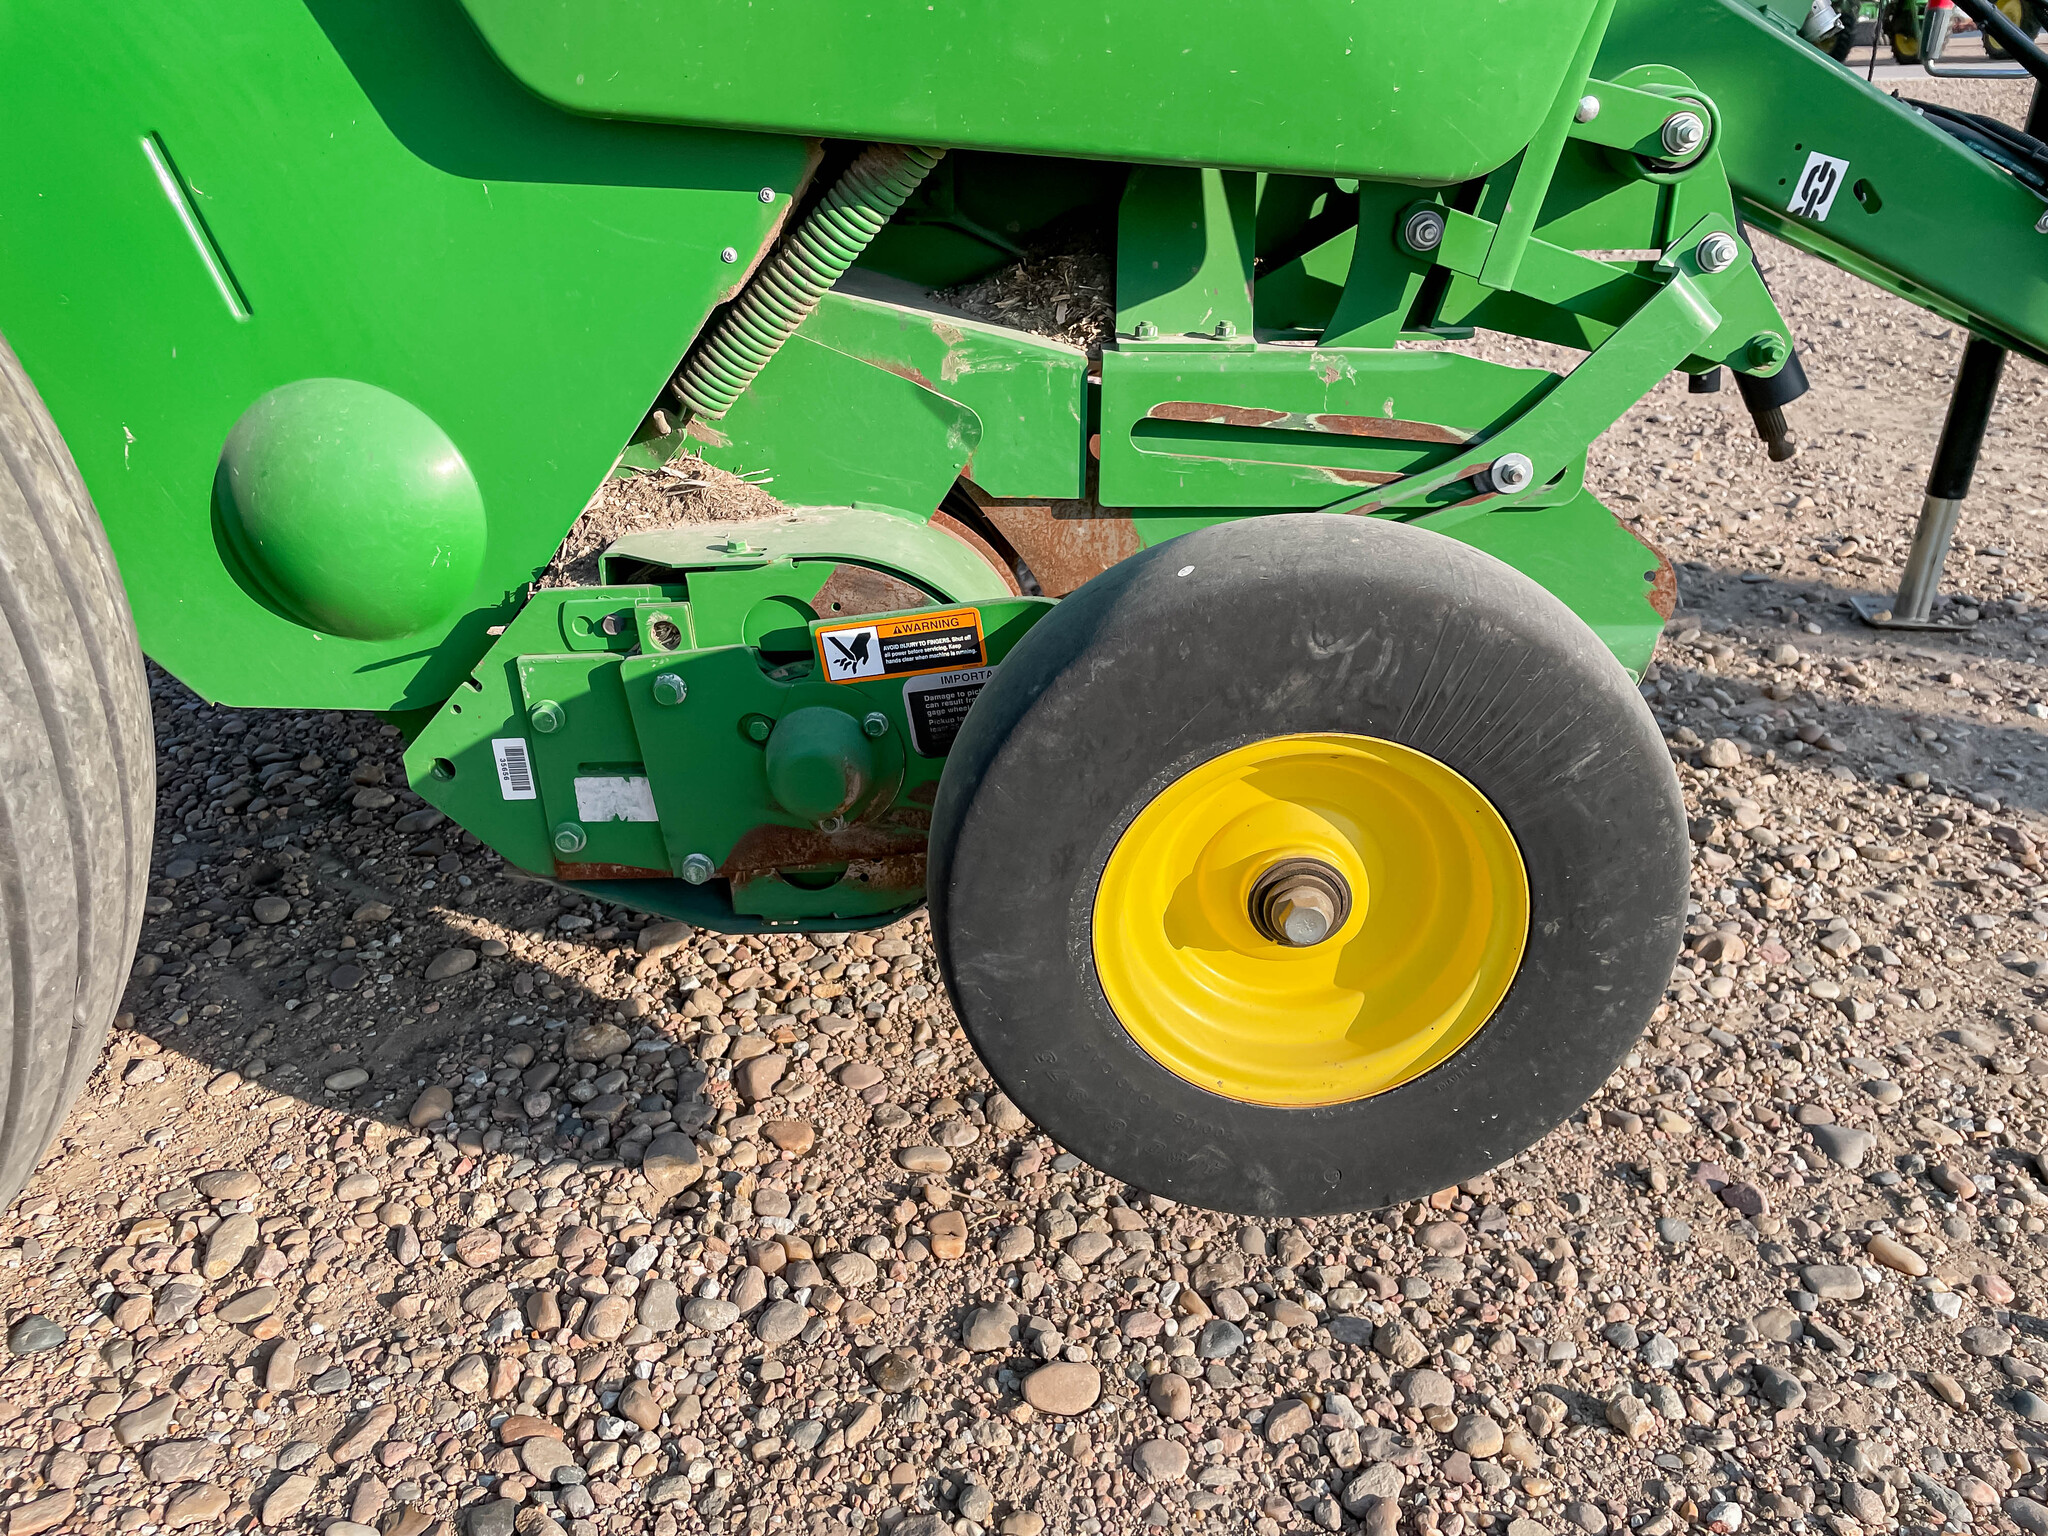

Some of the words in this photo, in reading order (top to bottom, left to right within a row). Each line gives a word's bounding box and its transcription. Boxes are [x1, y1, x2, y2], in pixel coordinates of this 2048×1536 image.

[902, 618, 959, 633] WARNING
[941, 670, 992, 684] IMPORTA
[924, 692, 955, 702] Damage
[941, 699, 964, 707] result
[927, 708, 946, 717] gage
[929, 717, 955, 725] Pickup
[500, 758, 509, 780] 35656
